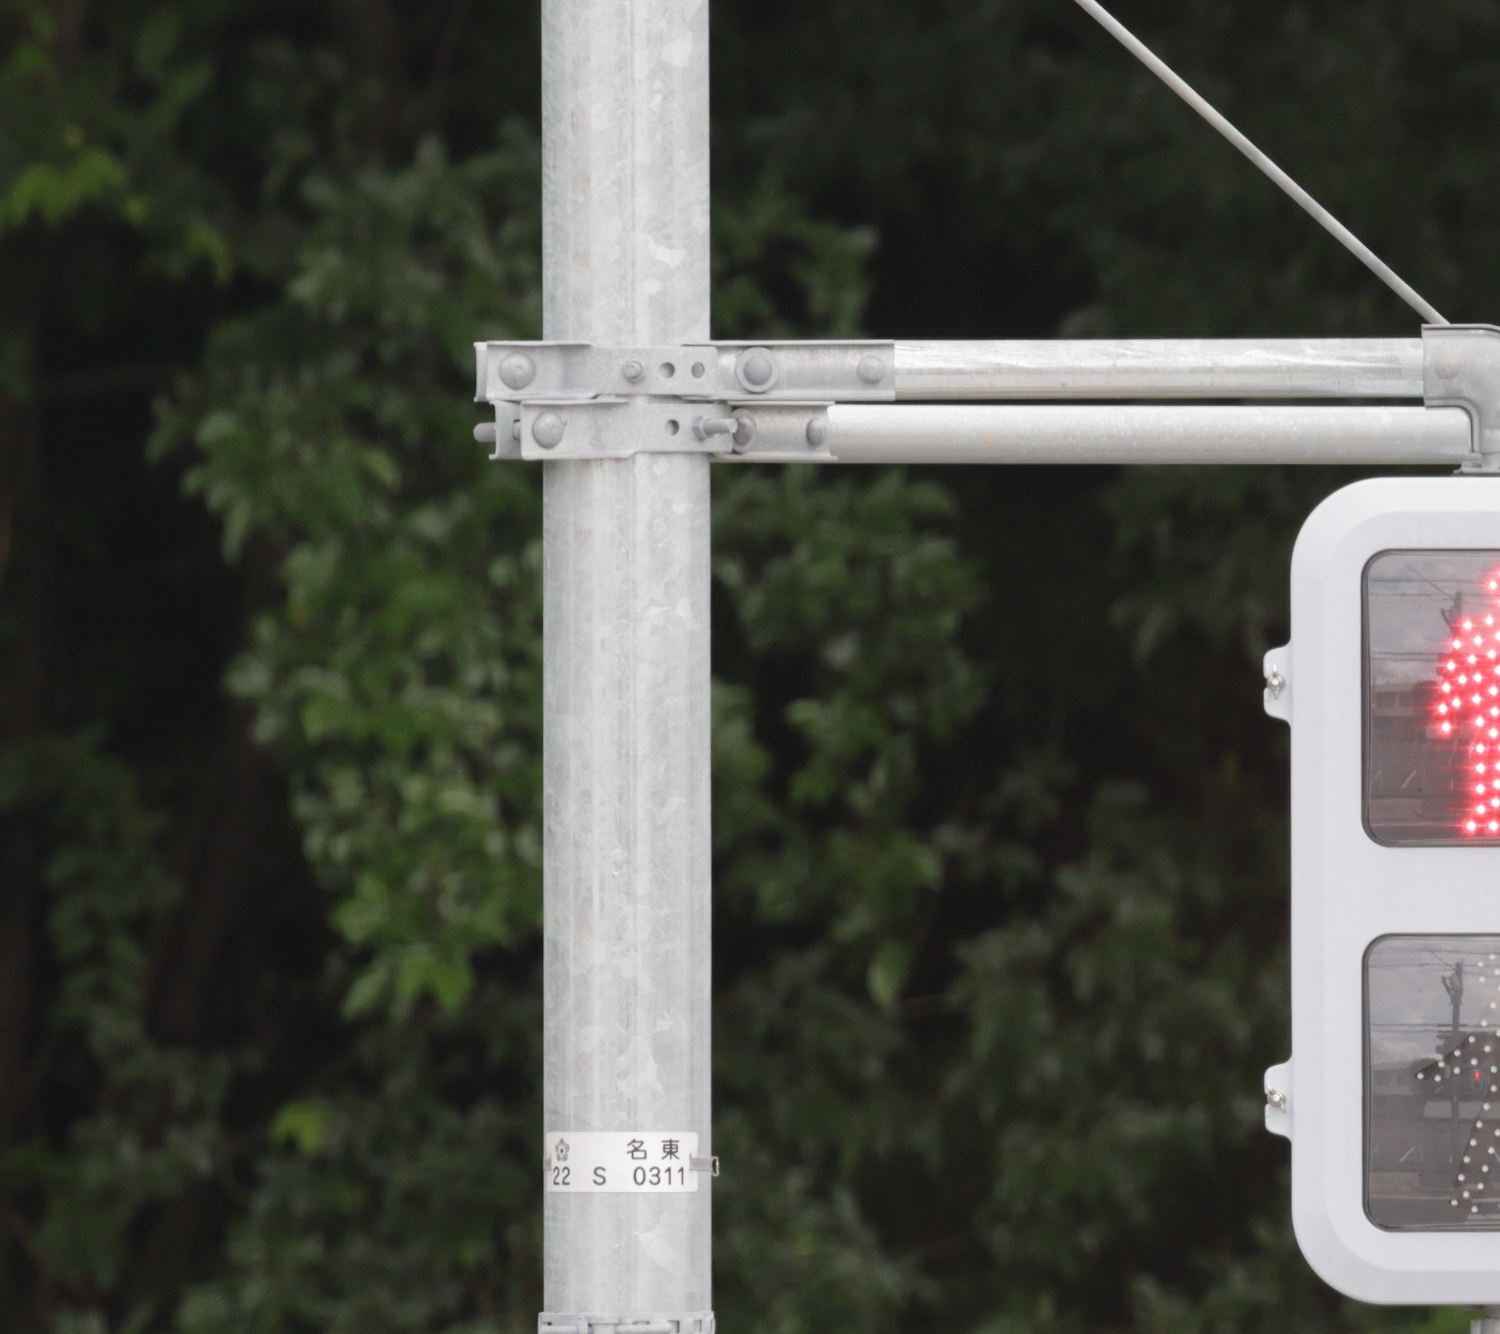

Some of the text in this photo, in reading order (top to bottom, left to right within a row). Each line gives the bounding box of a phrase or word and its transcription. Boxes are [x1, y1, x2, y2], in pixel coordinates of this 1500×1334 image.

[553, 1166, 685, 1186] 22 S 0311
